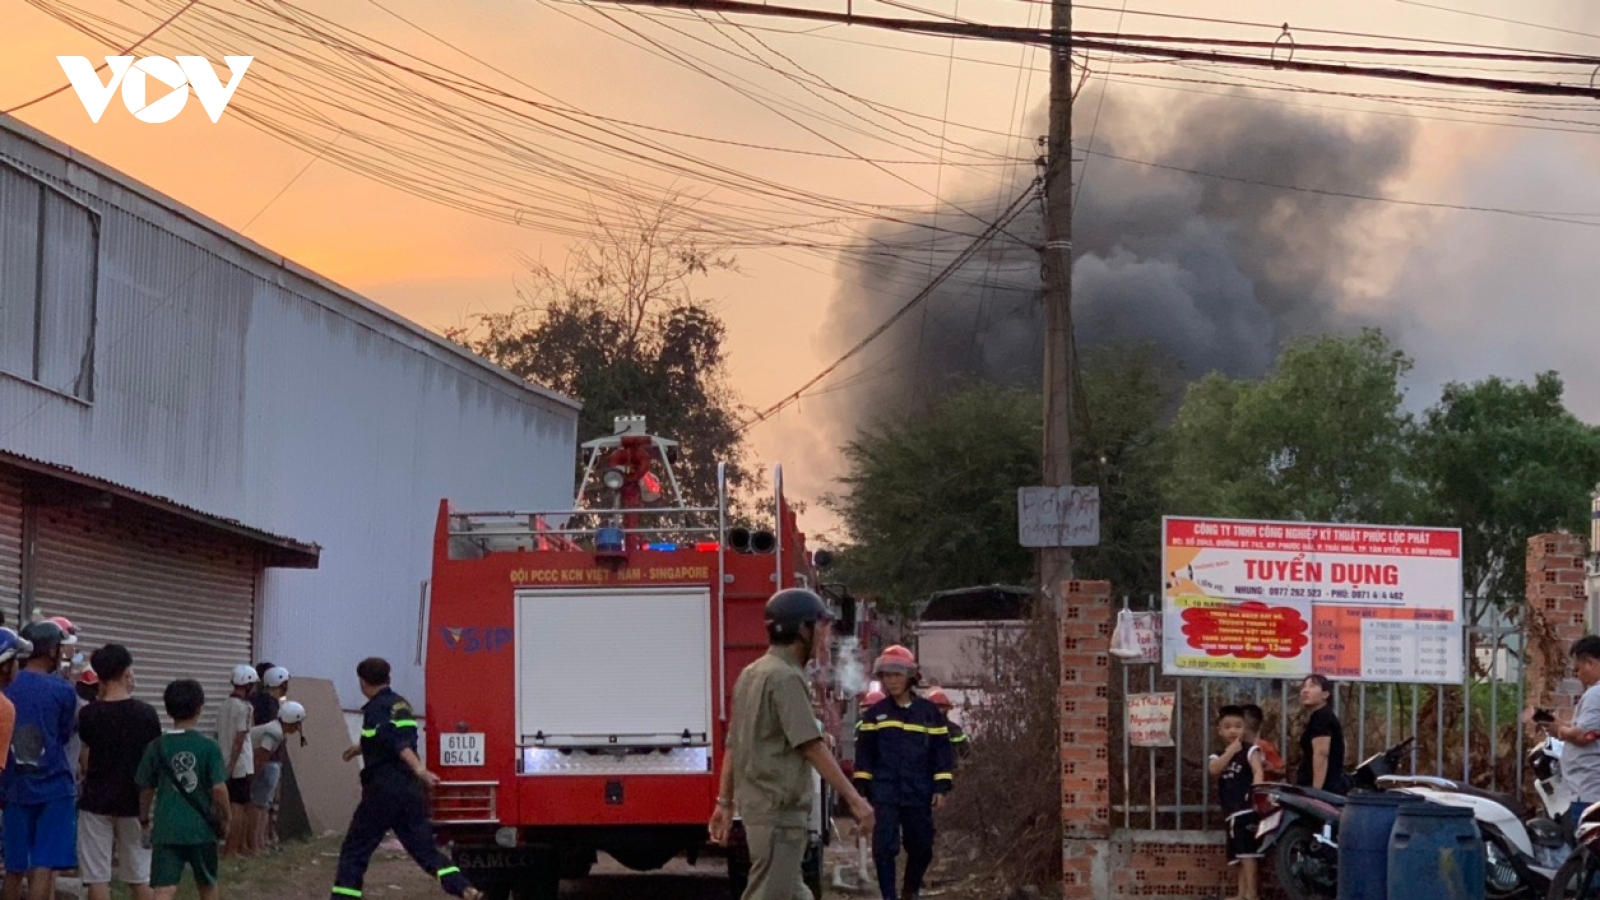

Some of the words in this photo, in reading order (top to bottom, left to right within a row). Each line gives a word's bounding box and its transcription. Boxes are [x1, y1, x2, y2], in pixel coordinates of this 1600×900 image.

[1193, 522, 1219, 536] CÔNG
[1220, 524, 1231, 536] TY
[1233, 525, 1257, 538] TNHH
[1260, 524, 1283, 538] CÔNG
[1285, 526, 1318, 541] NGHIỆP
[1334, 528, 1361, 544] THUẬT
[1363, 529, 1387, 543] PHÚC
[1389, 530, 1405, 546] LỘC
[1407, 531, 1430, 544] PHÁT
[510, 568, 529, 585] ĐỘI
[531, 569, 558, 582] PCCC
[561, 568, 584, 582] KCN
[618, 568, 641, 581] NAM
[649, 566, 710, 580] SINGAPORE
[1243, 553, 1322, 583] TUYỂN
[1331, 562, 1399, 589] DỤNG
[1234, 585, 1265, 595] NHUNG:
[439, 625, 513, 653] VSIP
[448, 736, 476, 750] 61LD
[444, 751, 480, 764] 054.14
